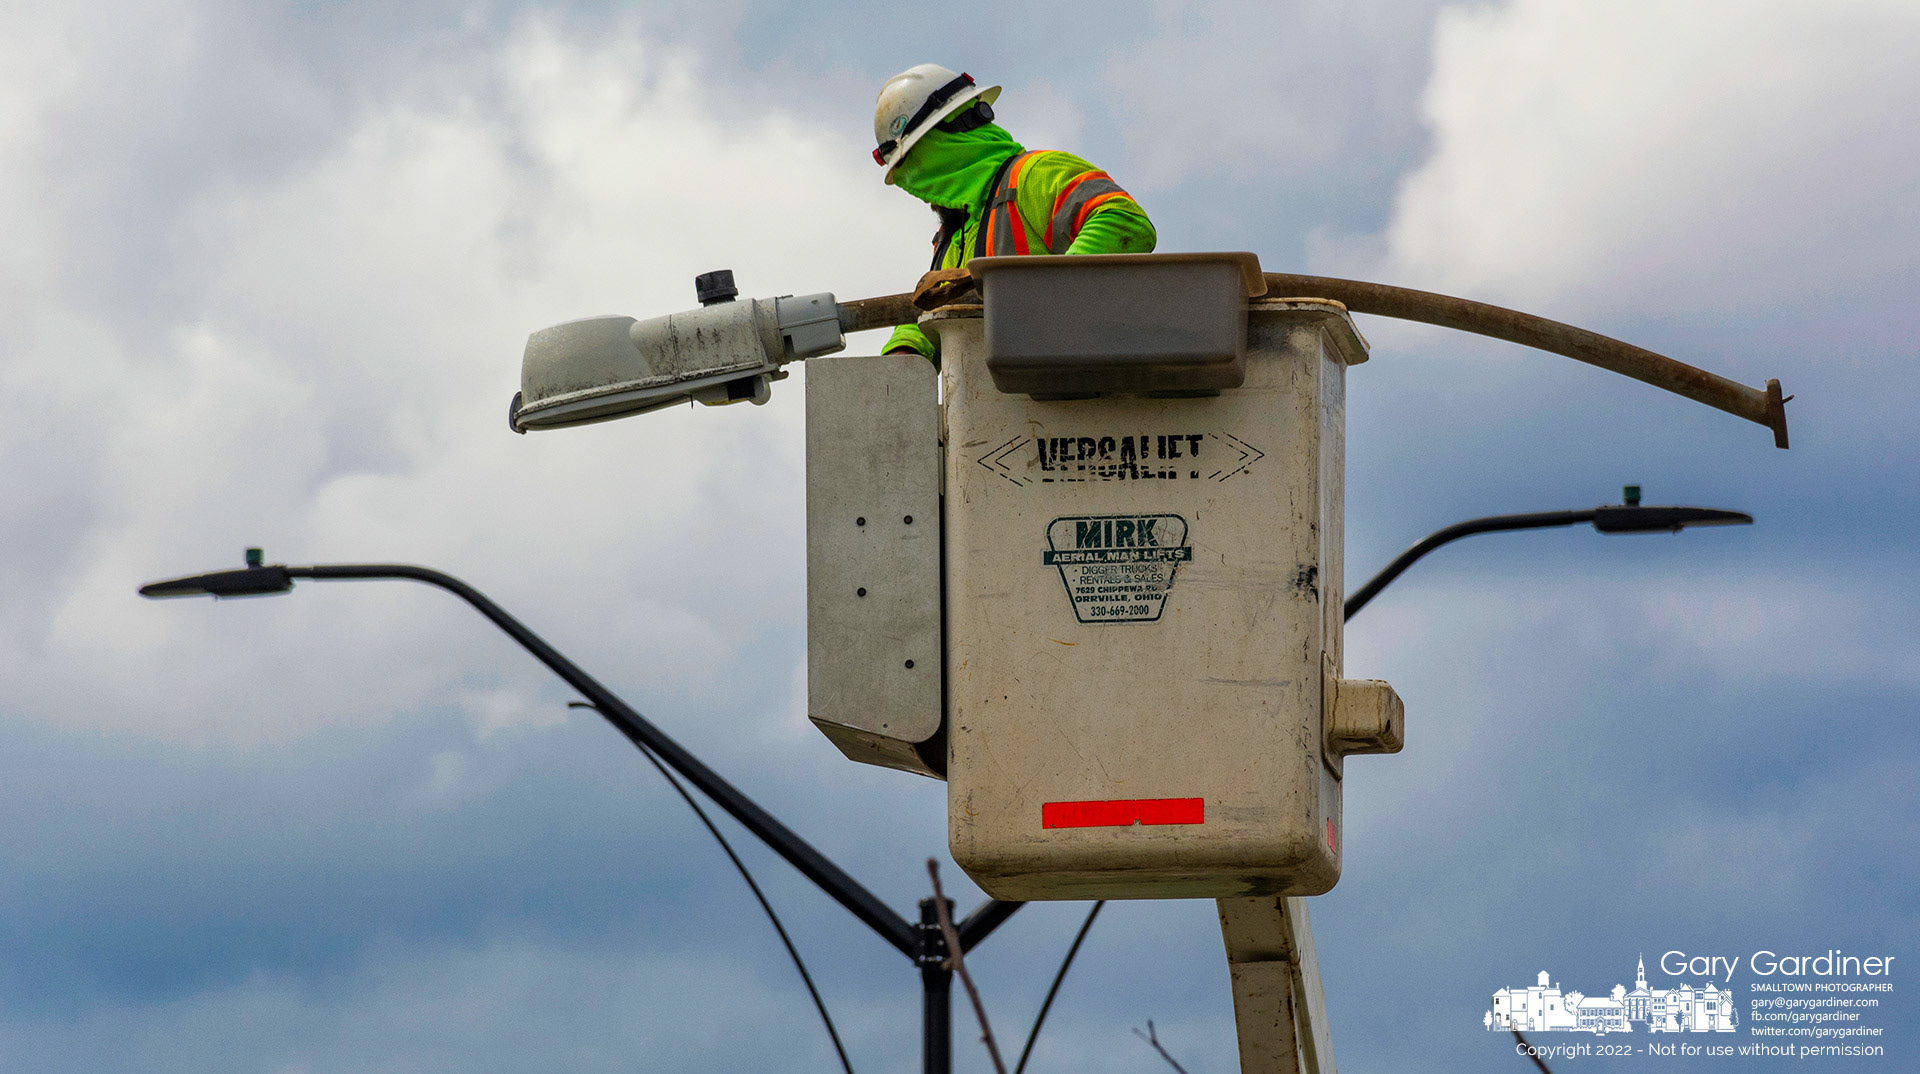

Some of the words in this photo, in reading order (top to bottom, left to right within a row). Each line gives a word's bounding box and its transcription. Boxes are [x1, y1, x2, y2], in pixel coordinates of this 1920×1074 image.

[1076, 519, 1159, 548] MIRK
[1052, 552, 1103, 562] AERIAL
[1107, 551, 1139, 561] MAN
[1144, 549, 1185, 560] LIFTS
[1081, 565, 1118, 575] DIGGER
[1120, 564, 1158, 574] TRUCKS
[1080, 575, 1121, 585] RENTALS
[1134, 573, 1163, 583] SALES
[1097, 585, 1144, 594] CHIPPEWA
[1075, 593, 1131, 603] ORRVILLE,
[1134, 593, 1162, 601] OHIO
[1090, 605, 1150, 616] 330-669-2000
